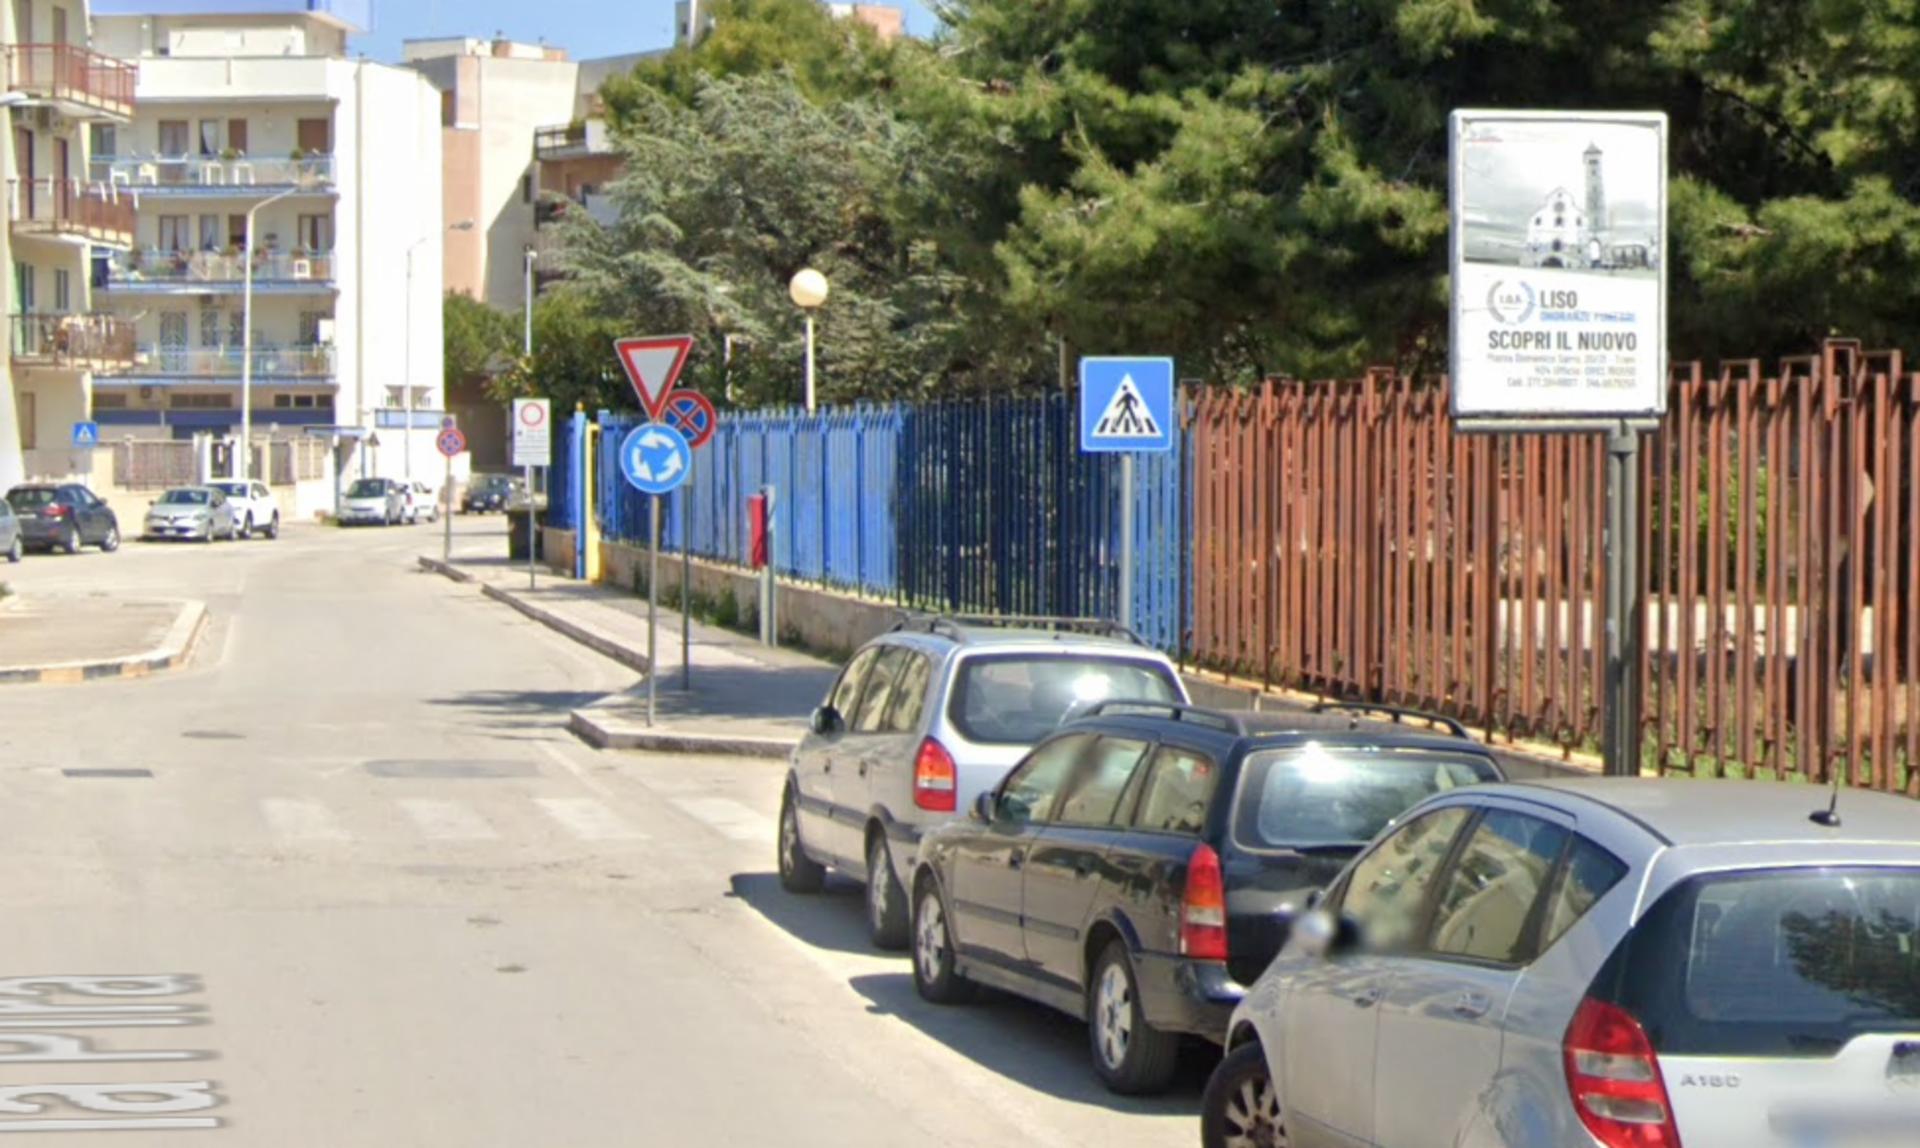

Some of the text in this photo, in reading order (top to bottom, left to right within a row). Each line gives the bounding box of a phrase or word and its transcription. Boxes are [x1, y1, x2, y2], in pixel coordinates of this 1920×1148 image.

[1540, 290, 1578, 309] LISO
[1488, 329, 1637, 351] SCOPRI IL NUOVO
